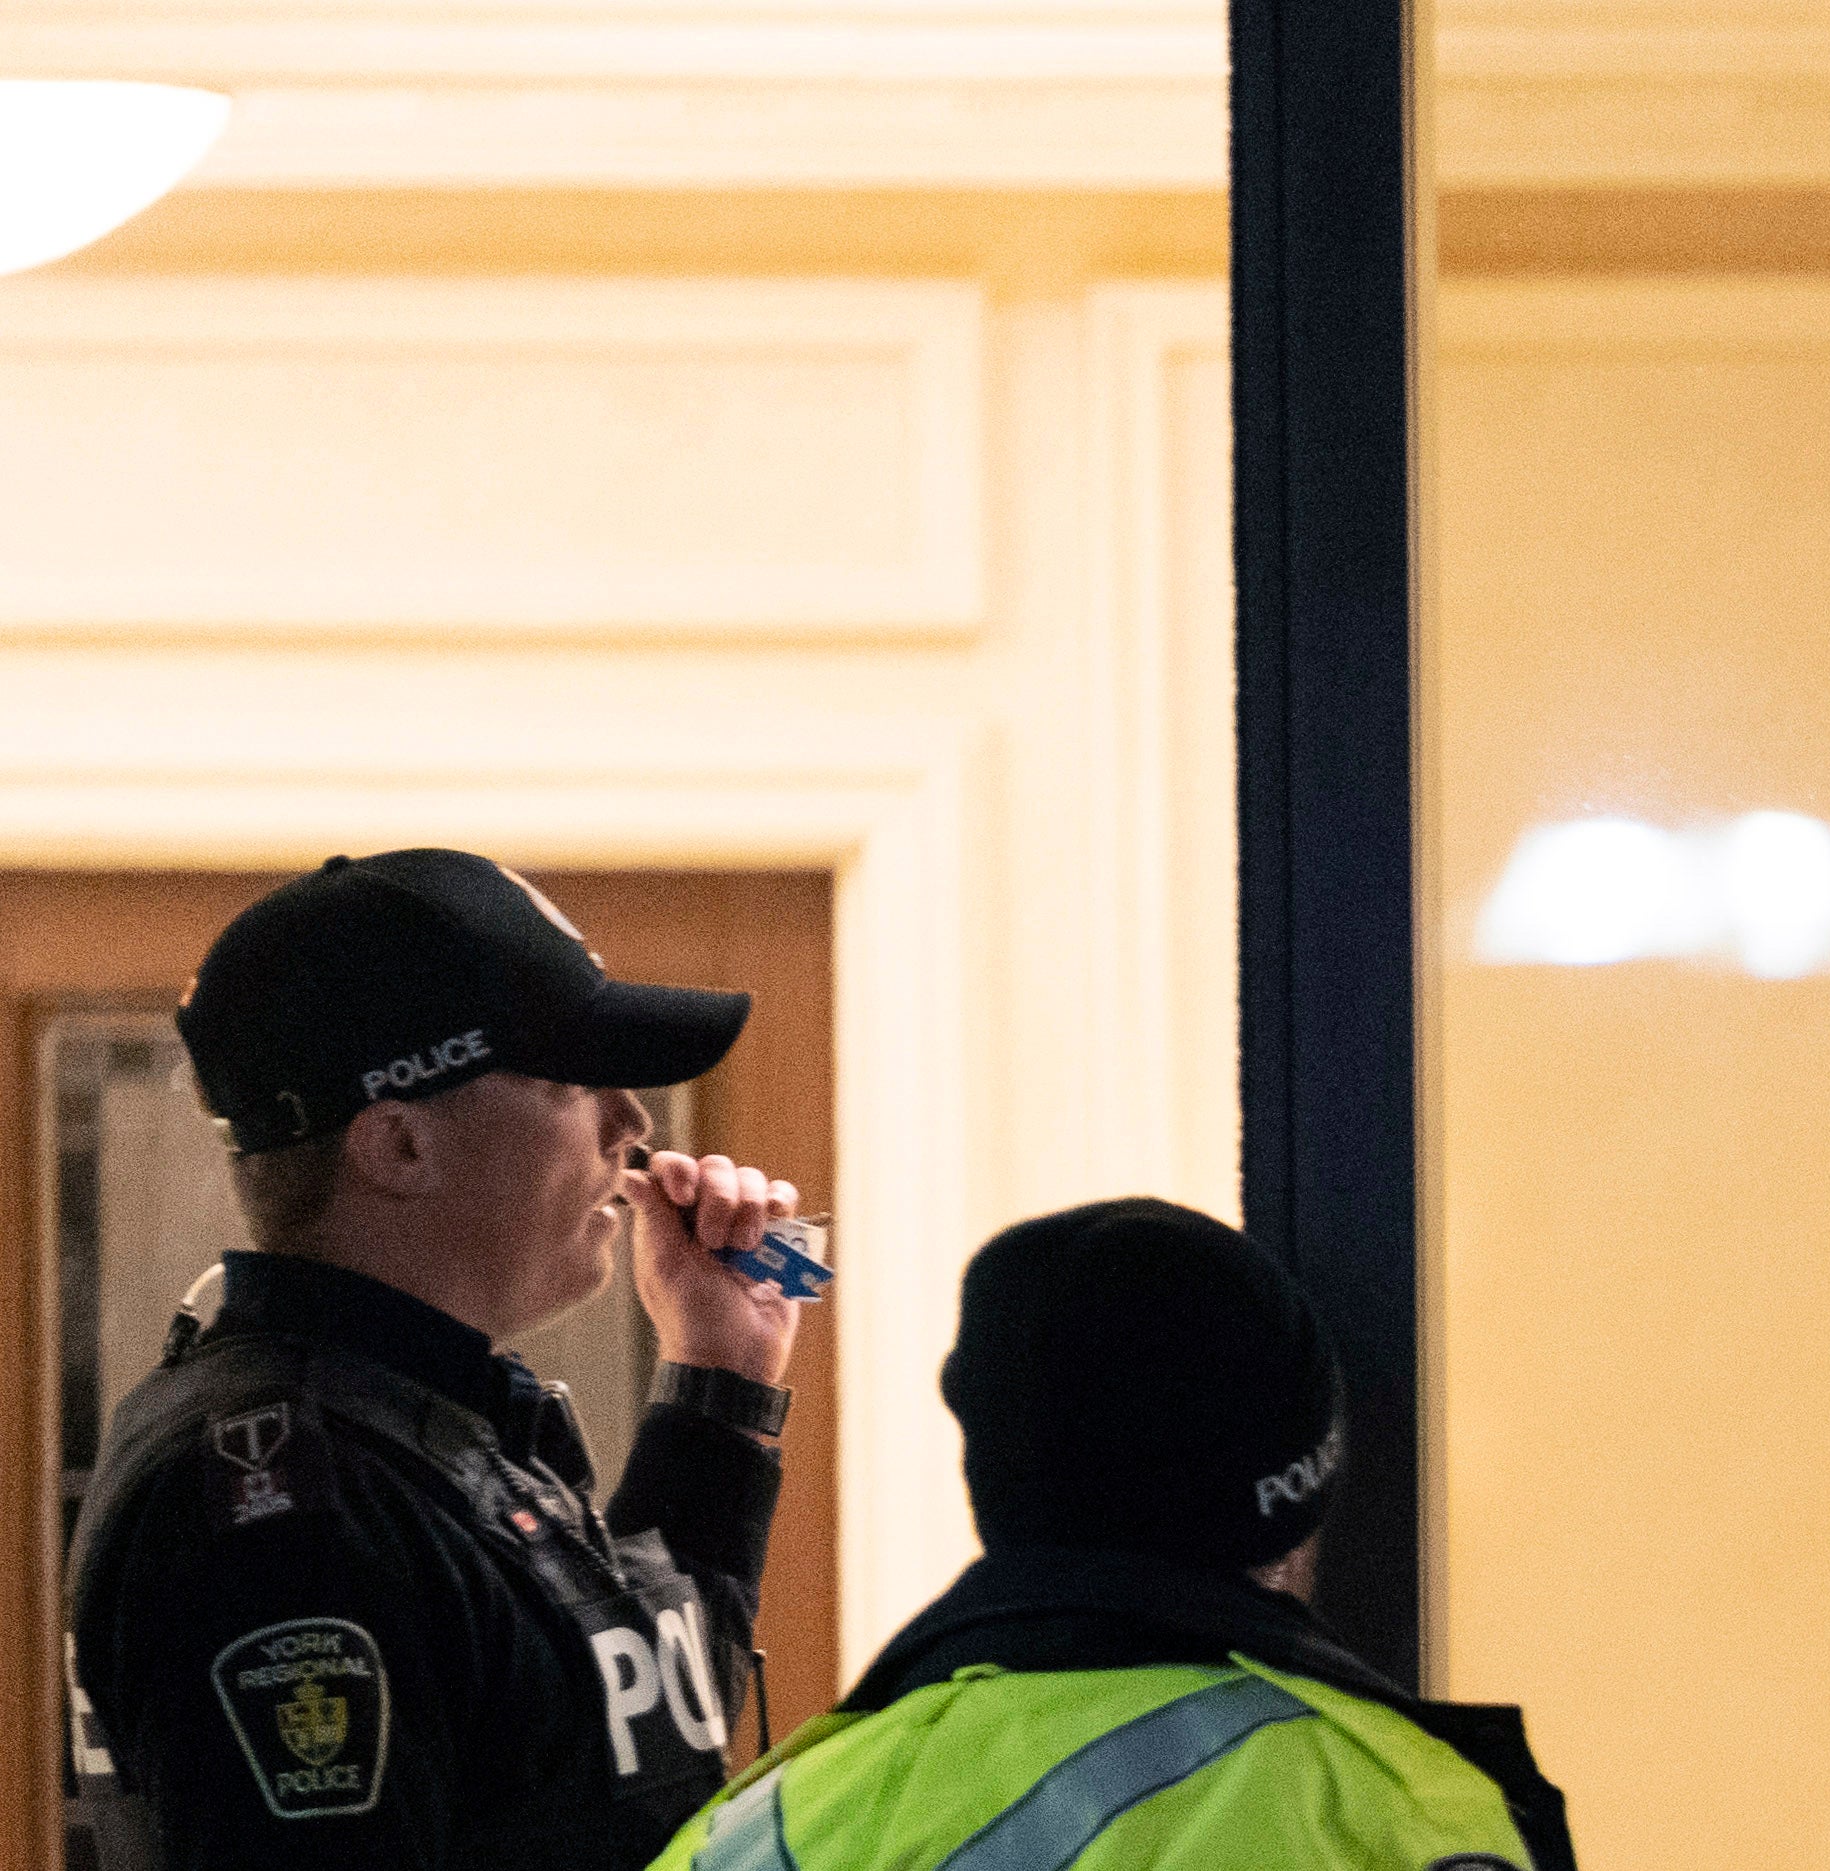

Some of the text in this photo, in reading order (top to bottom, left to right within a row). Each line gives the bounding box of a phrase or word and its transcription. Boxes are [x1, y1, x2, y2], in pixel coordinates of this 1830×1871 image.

[362, 1029, 491, 1100] POLICE
[259, 1631, 343, 1661] YORK
[236, 1656, 375, 1690] REGIONAL
[276, 1764, 361, 1797] POLICE
